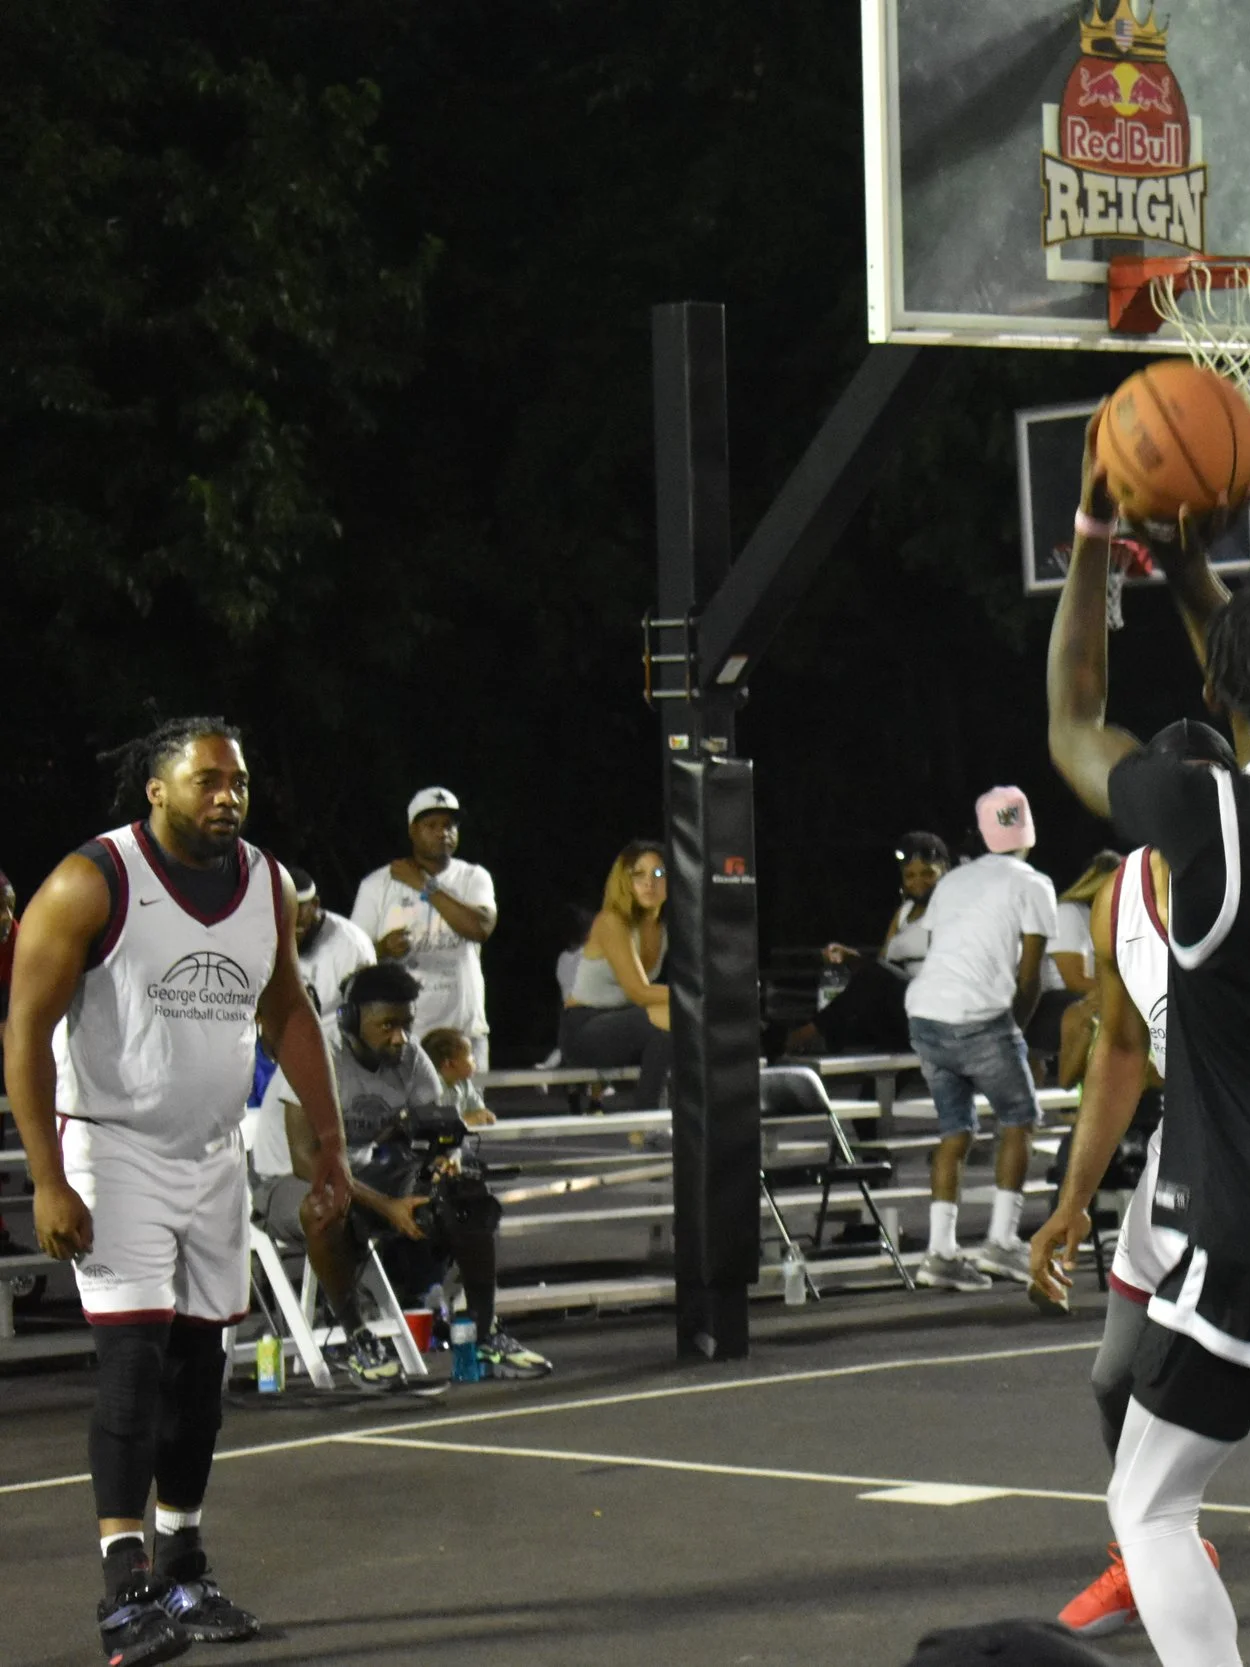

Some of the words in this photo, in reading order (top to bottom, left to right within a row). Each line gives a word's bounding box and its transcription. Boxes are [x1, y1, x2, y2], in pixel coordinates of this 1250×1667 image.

[1066, 115, 1126, 163] Red
[1127, 122, 1183, 168] Bull
[1043, 156, 1205, 252] REIGN
[146, 983, 197, 1006] George
[199, 987, 256, 1006] Goodman
[154, 1003, 213, 1021] Roundball
[215, 1007, 249, 1022] Classic
